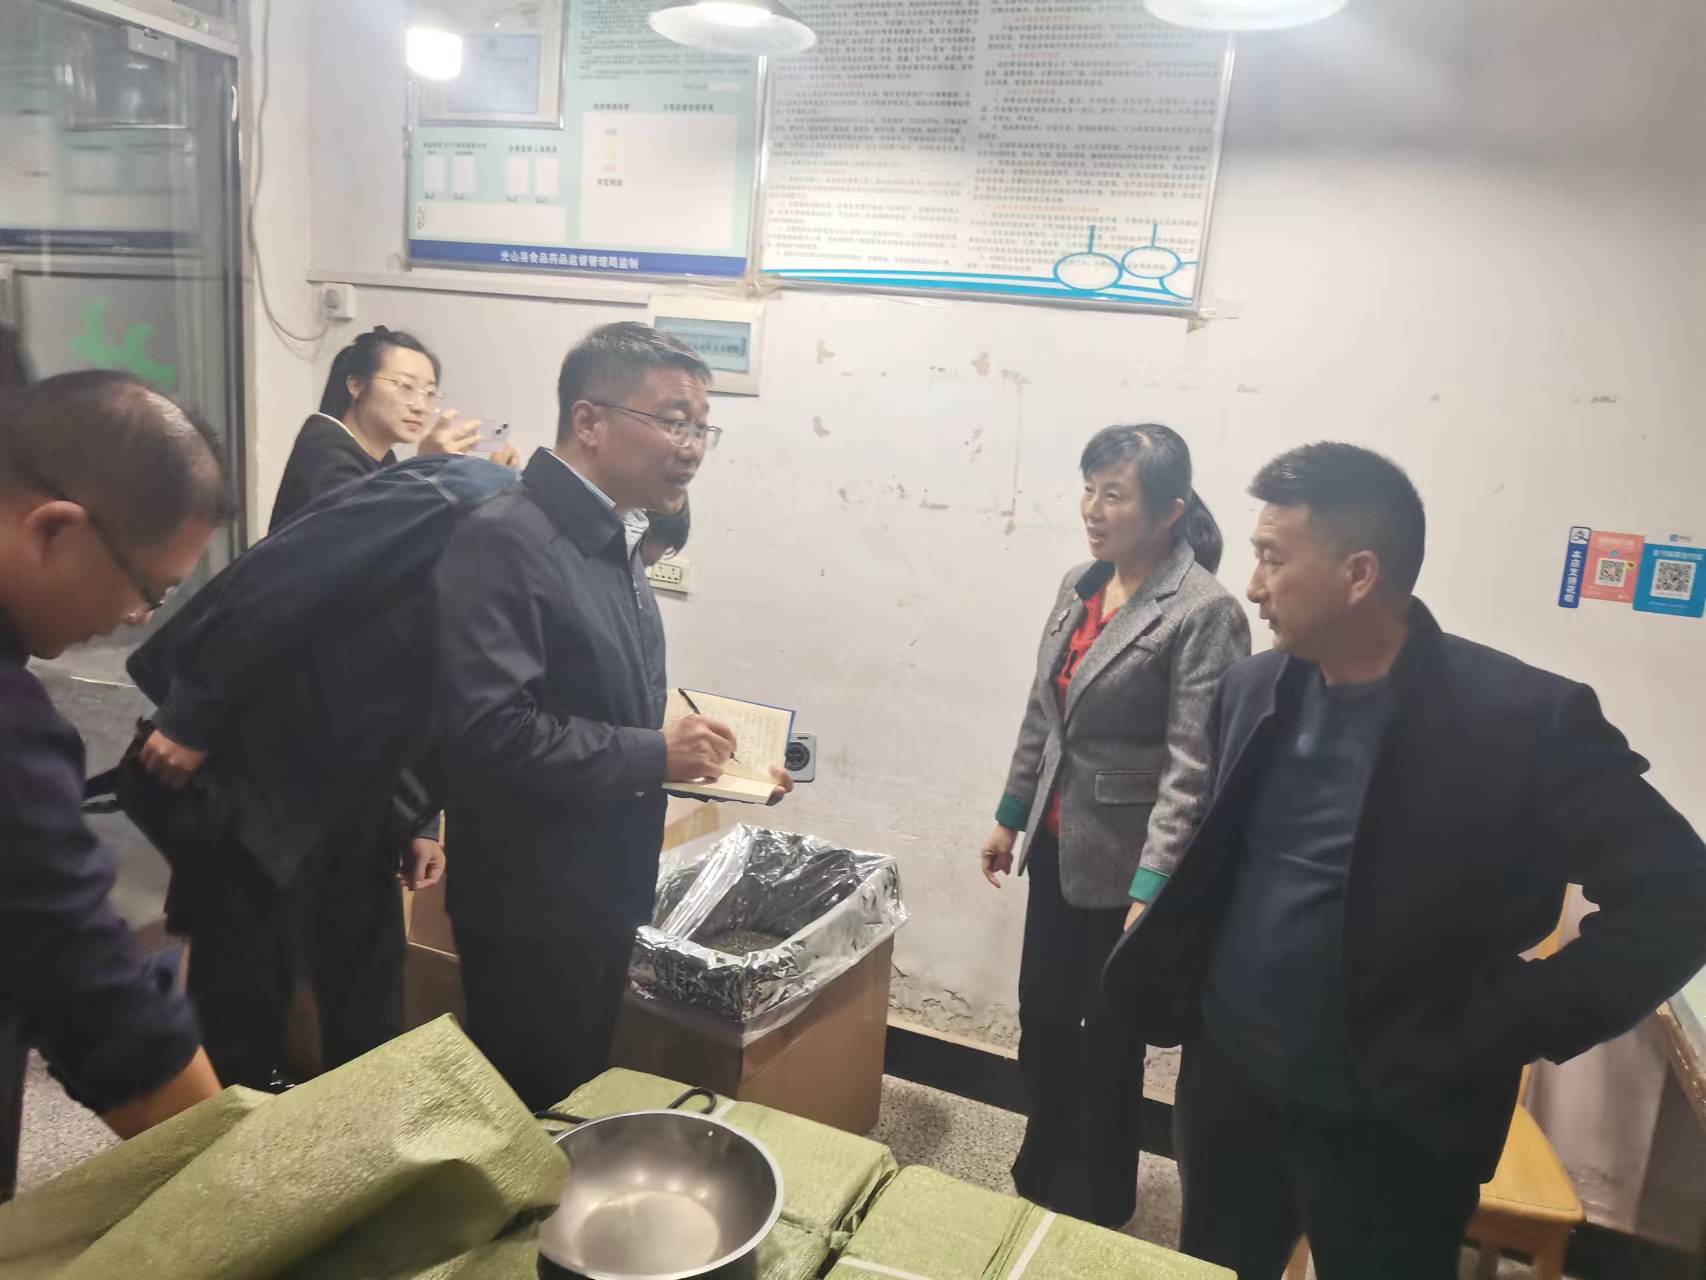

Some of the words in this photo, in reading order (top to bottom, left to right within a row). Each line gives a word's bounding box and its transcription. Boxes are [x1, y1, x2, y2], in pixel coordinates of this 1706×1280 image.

[499, 250, 640, 270] 光山县食品药品监督管理局监制
